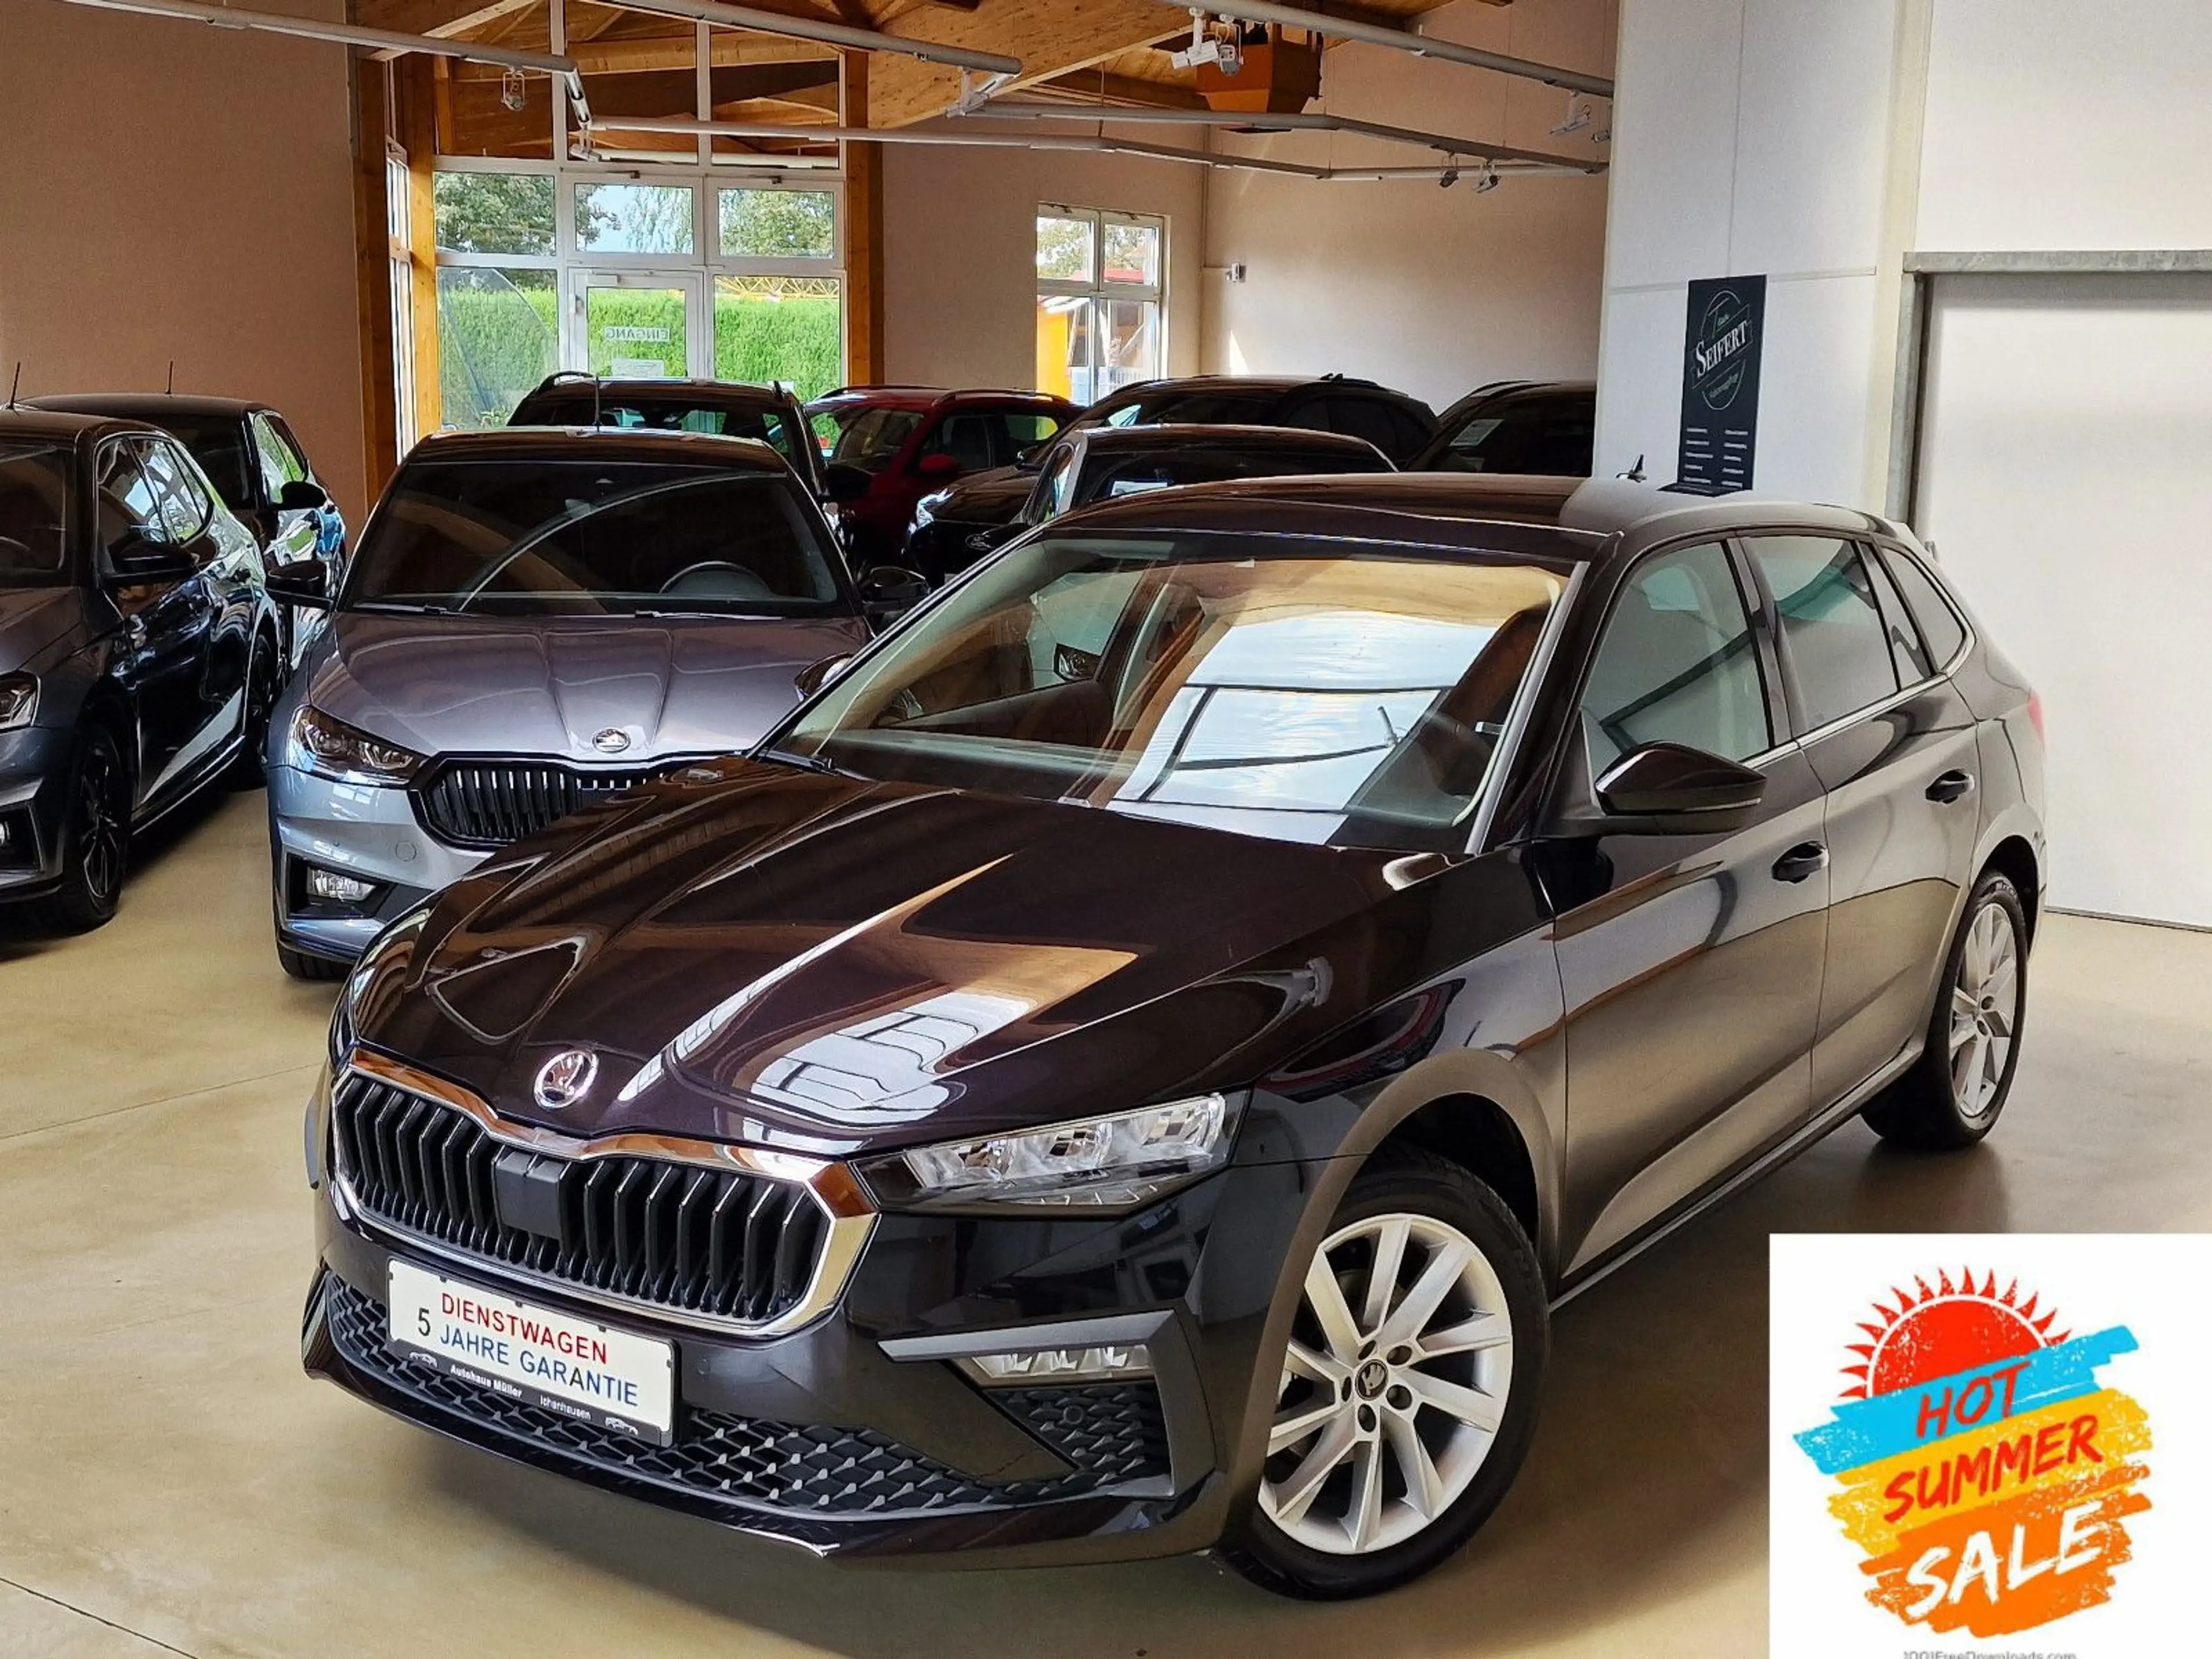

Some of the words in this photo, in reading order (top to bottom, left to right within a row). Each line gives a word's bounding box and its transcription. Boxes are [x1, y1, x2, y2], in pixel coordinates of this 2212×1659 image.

[1696, 320, 1747, 379] SEIFERT
[418, 1308, 431, 1336] 5
[440, 1324, 509, 1365] JAHRE
[520, 1350, 638, 1407] GARANTIE
[442, 1293, 607, 1365] DIENSTWAGEN
[450, 1364, 492, 1387] Autohaus
